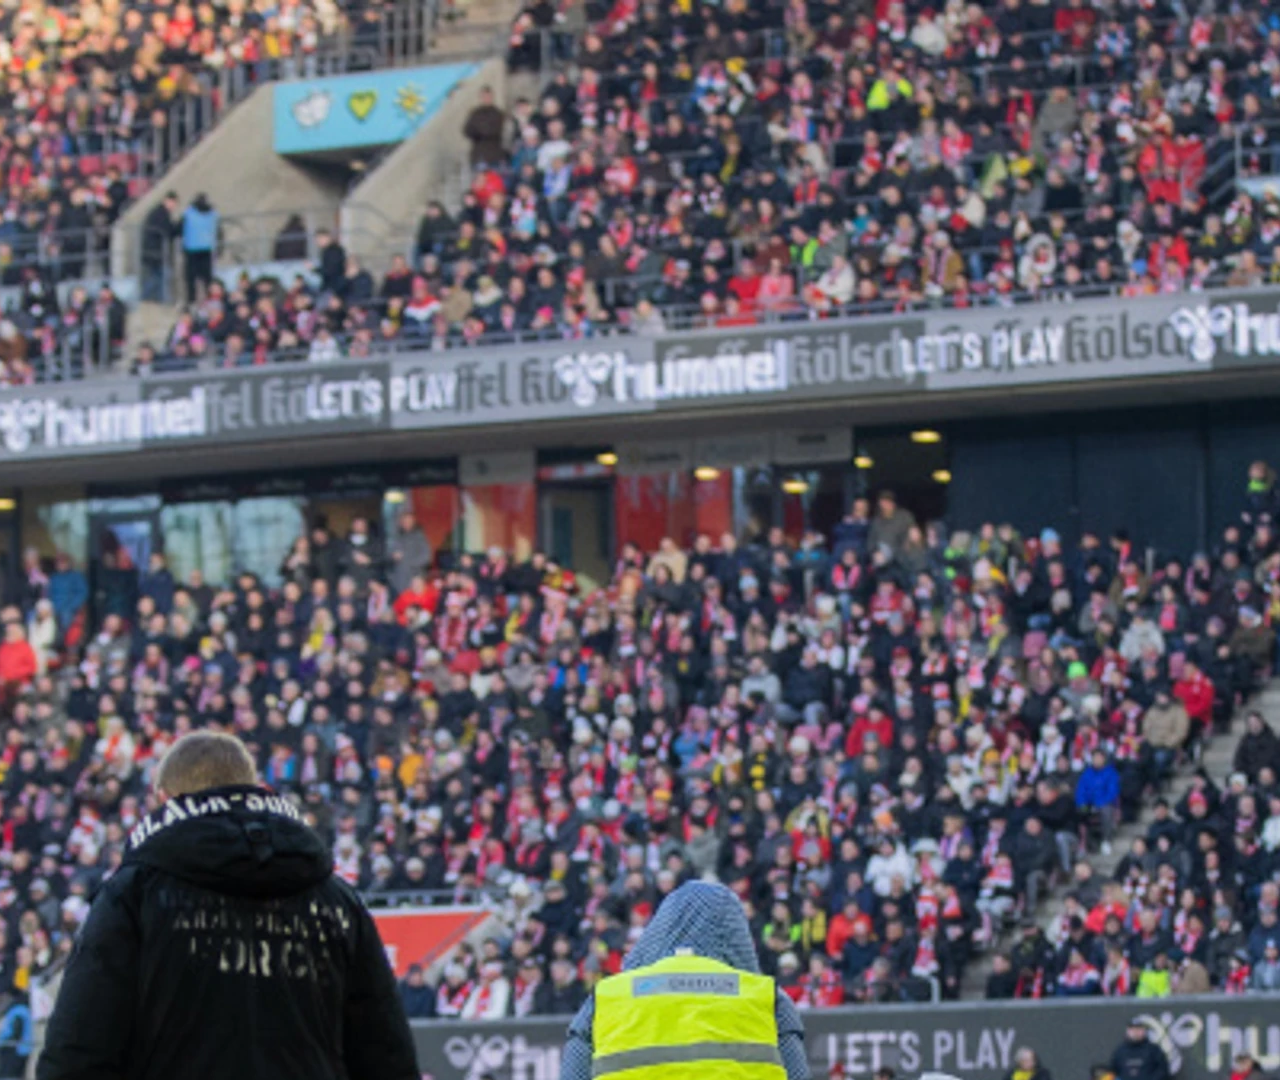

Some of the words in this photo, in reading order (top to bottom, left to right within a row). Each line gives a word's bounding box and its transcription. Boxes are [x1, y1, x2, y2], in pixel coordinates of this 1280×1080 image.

[613, 338, 787, 402] hummel
[901, 331, 983, 375] LET'S
[991, 325, 1064, 367] PLAY
[44, 386, 206, 447] hummel
[308, 377, 383, 420] LET'S
[389, 372, 458, 412] PLAY
[827, 1029, 920, 1074] LET'S
[933, 1027, 1016, 1073] PLAY
